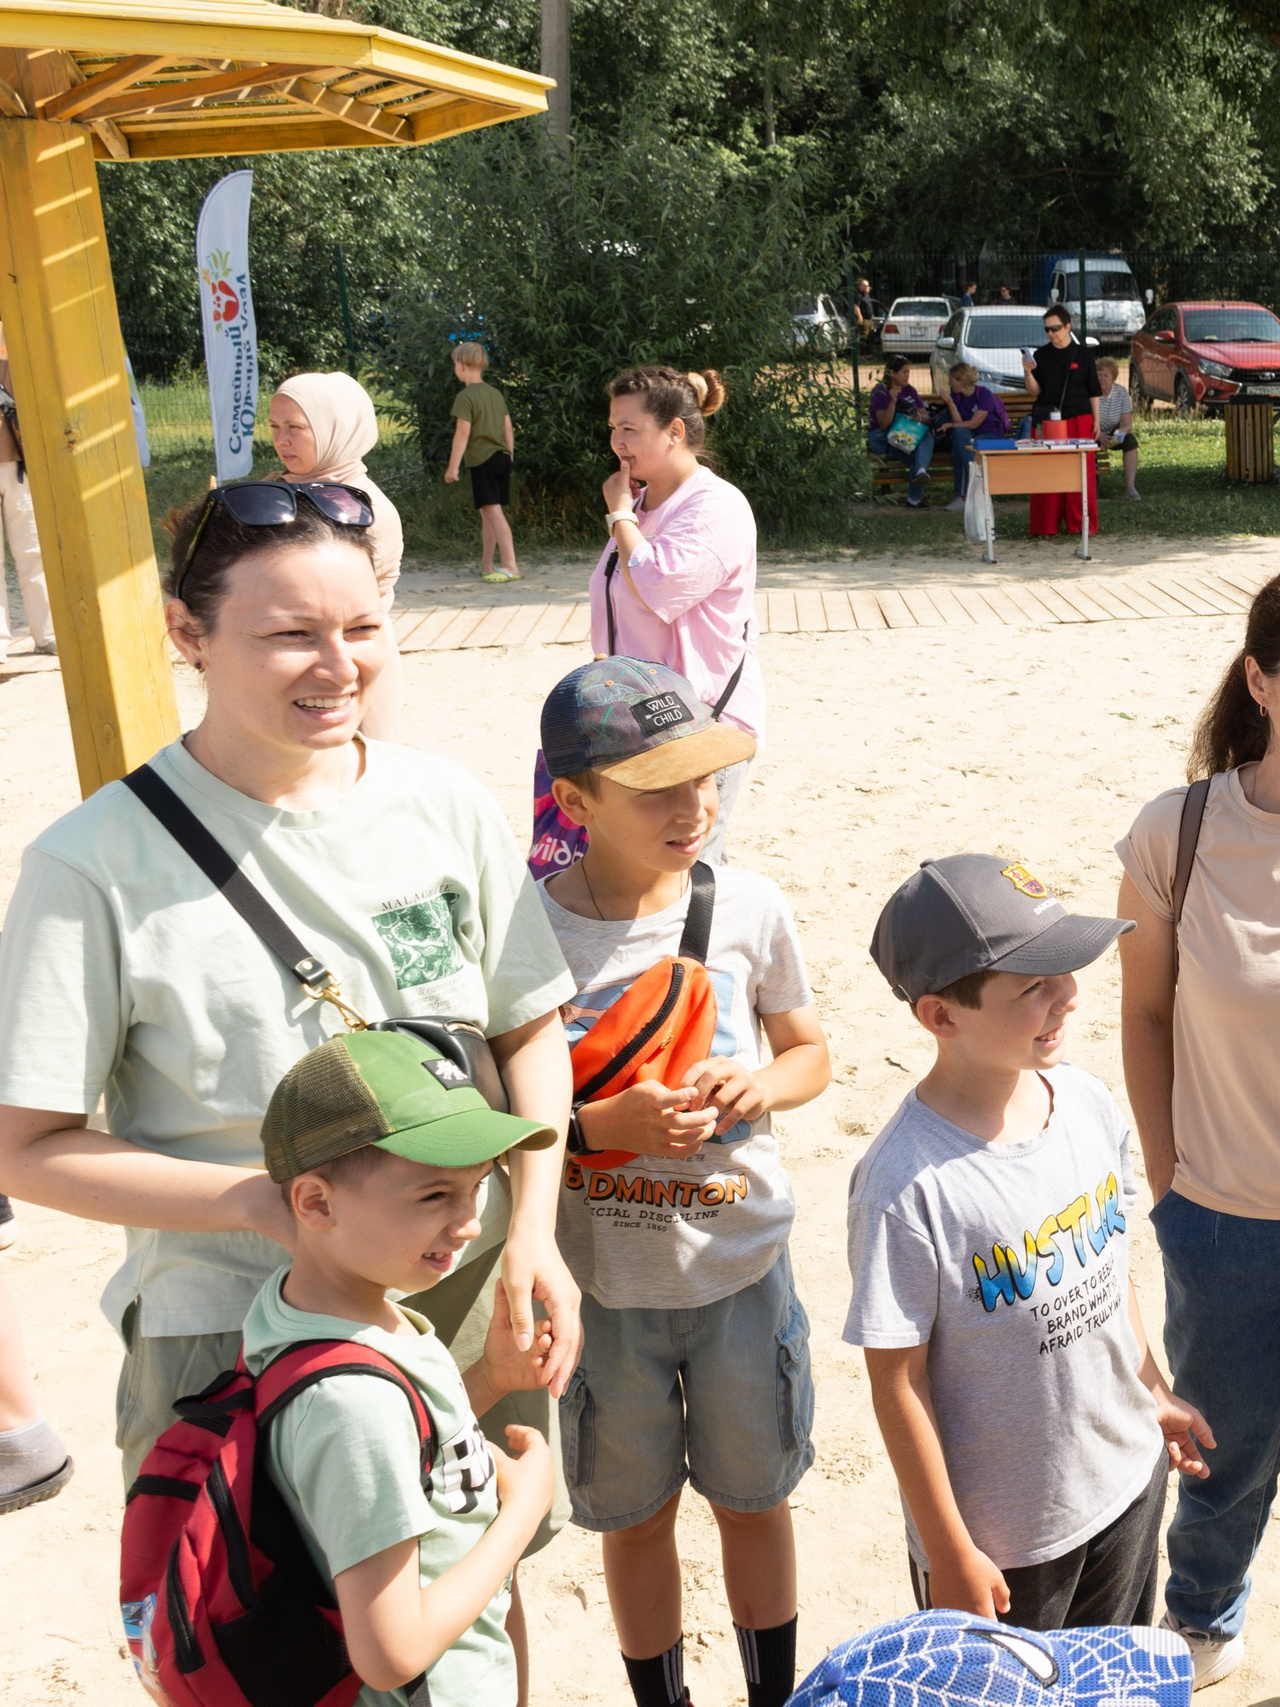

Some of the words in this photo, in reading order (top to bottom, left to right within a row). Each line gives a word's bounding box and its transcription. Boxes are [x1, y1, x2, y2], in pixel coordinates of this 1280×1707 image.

[225, 325, 243, 455] Семейный
[646, 695, 676, 712] WILD
[653, 709, 683, 727] CHILD
[564, 1160, 748, 1208] BDMINTON
[613, 1220, 641, 1229] SINCE
[647, 1222, 667, 1232] 1860
[1030, 1303, 1050, 1322] TO
[1054, 1286, 1083, 1310] OVER
[1083, 1275, 1098, 1296] TO
[1047, 1306, 1090, 1334] BRAND
[1089, 1282, 1112, 1315] WHAT
[1039, 1326, 1084, 1355] AFRAID
[1085, 1302, 1113, 1333] TRULY
